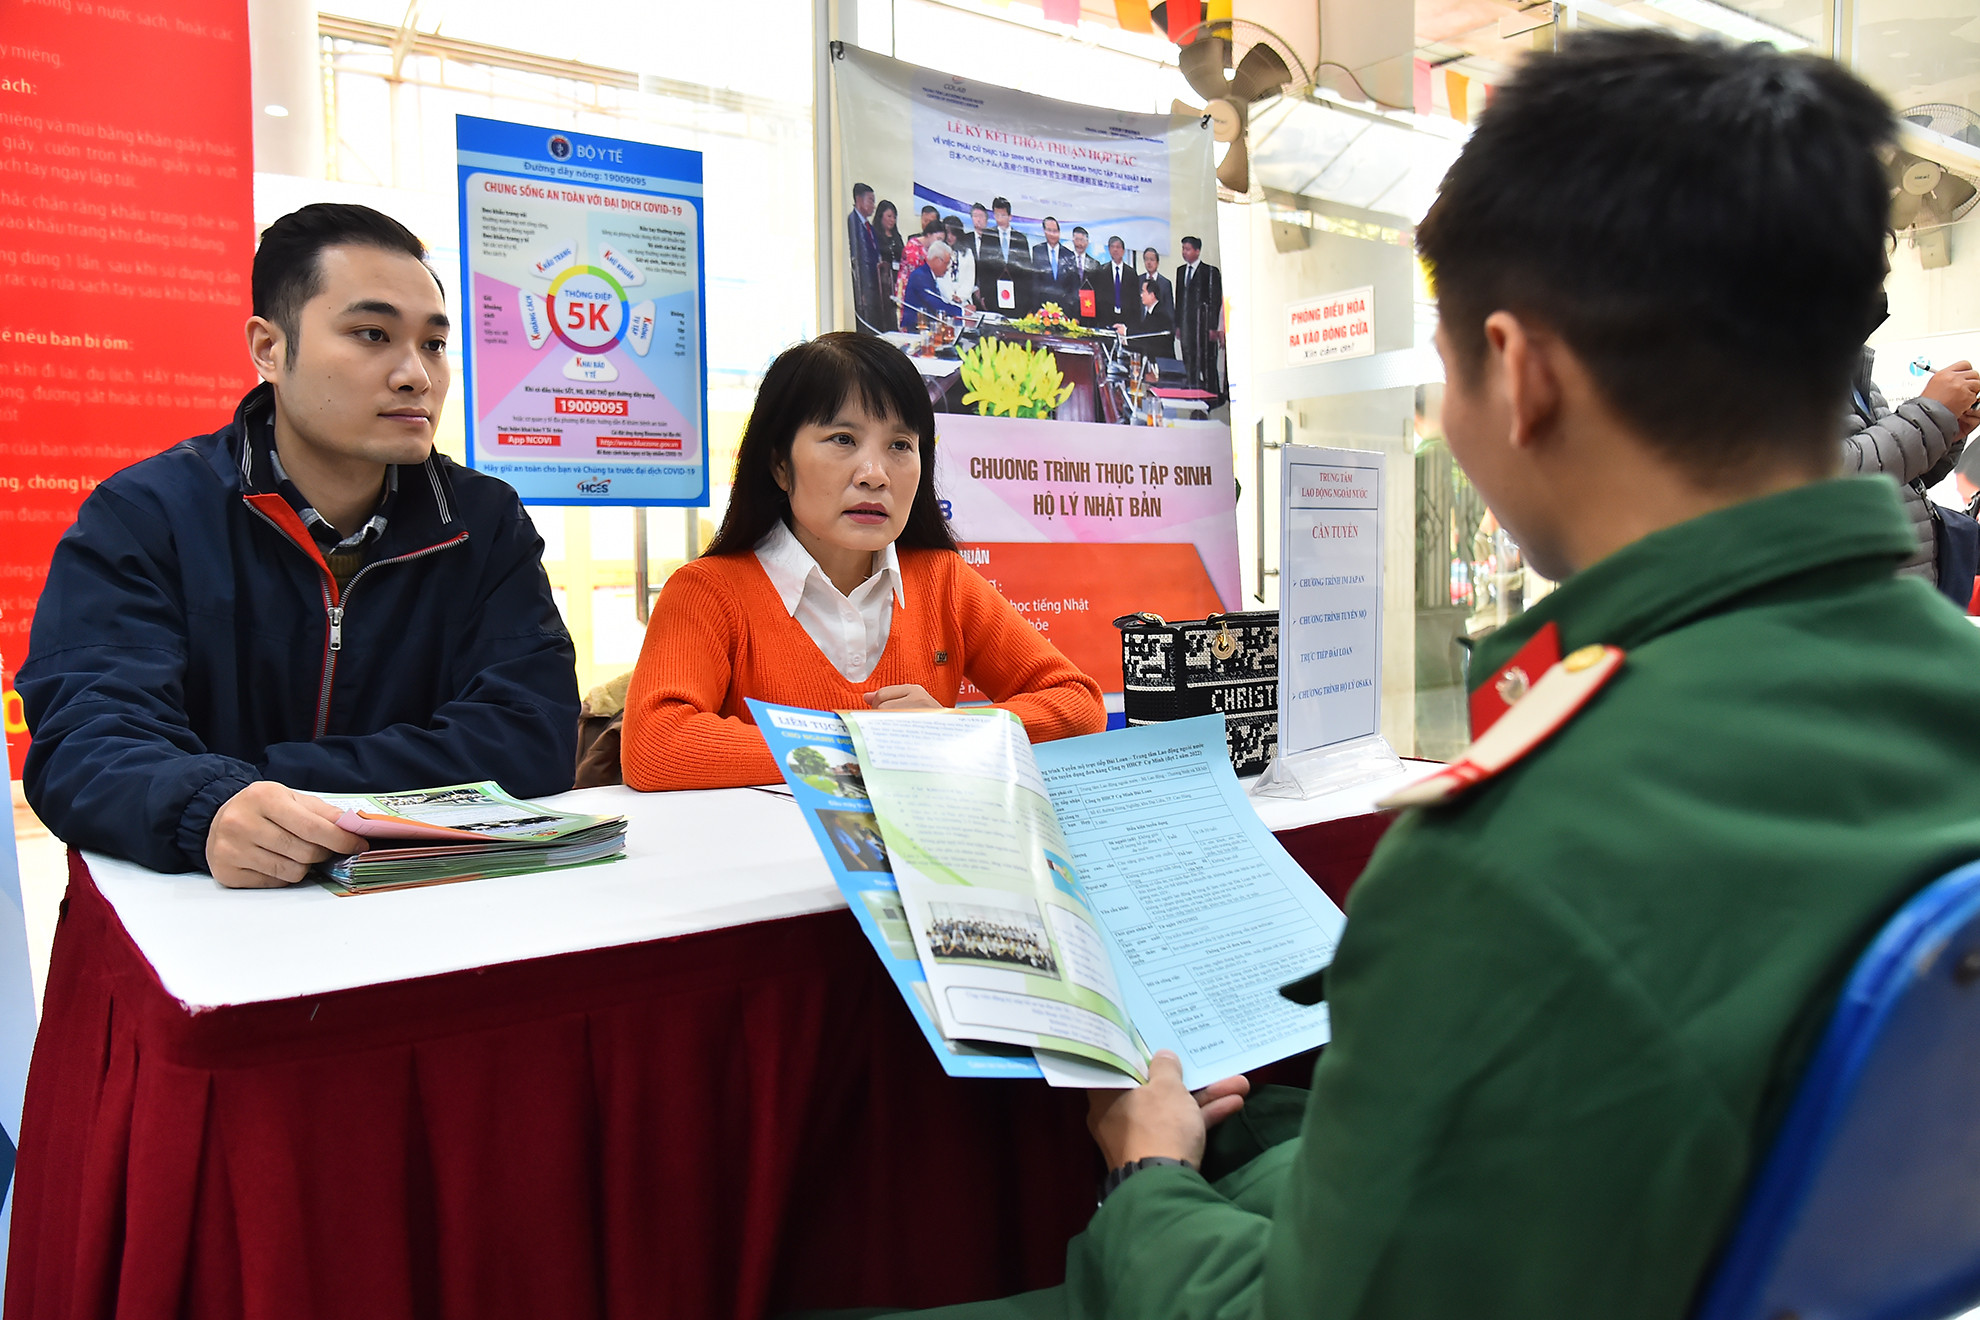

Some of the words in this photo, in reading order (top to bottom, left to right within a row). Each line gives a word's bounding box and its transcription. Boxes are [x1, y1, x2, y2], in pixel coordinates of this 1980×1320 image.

[577, 144, 596, 162] BỘ
[598, 148, 606, 160] Y
[608, 148, 623, 164] TẾ
[986, 128, 1009, 144] KẾT
[1048, 140, 1087, 160] THUẬN
[1088, 149, 1112, 164] HỢP
[1114, 152, 1138, 167] TÁC
[524, 162, 556, 175] Đường
[557, 166, 574, 178] dây
[604, 172, 647, 186] 19009095
[484, 181, 518, 196] CHUNG
[520, 184, 545, 199] SỐNG
[547, 190, 560, 200] AN
[562, 190, 585, 204] TOÀN
[587, 194, 602, 206] VỚI
[604, 196, 619, 210] ĐẠI
[621, 199, 642, 212] DỊCH
[644, 202, 682, 216] COVID-19
[564, 289, 593, 300] THÔNG
[567, 302, 610, 332] 5K
[1292, 307, 1321, 326] PHÒNG
[1324, 300, 1344, 319] ĐIỀU
[1347, 298, 1365, 314] HÒA
[15, 327, 47, 345] nếu
[1290, 334, 1300, 347] RA
[1302, 329, 1320, 344] VÀO
[1350, 318, 1368, 336] CỬA
[560, 400, 624, 414] 19009095
[508, 436, 526, 445] App
[526, 436, 552, 444] NCOVI
[544, 466, 556, 474] cho
[970, 457, 1038, 481] CHƯƠNG
[1044, 457, 1090, 482] TRÌNH
[1096, 462, 1134, 488] THỰC
[1139, 461, 1169, 489] TẬP
[1174, 465, 1212, 486] SINH
[1320, 472, 1340, 482] TRUNG
[1340, 472, 1353, 483] TÂM
[1302, 488, 1314, 498] LAO
[1316, 486, 1332, 500] ĐỘNG
[1033, 490, 1055, 520] HỘ
[1060, 491, 1078, 516] LÝ
[1084, 493, 1124, 522] NHẬT
[1130, 490, 1162, 518] BẢN
[1312, 522, 1330, 539] CẦN
[1300, 578, 1324, 588] CHƯƠNG
[1324, 574, 1340, 586] TRÌNH
[1348, 575, 1365, 584] JAPAN
[1033, 596, 1062, 614] tiếng
[1064, 598, 1089, 614] Nhật
[1300, 614, 1324, 626] CHƯƠNG
[1324, 611, 1340, 622] TRÌNH
[1339, 646, 1352, 656] LOAN
[1298, 688, 1322, 700] CHƯƠNG
[1323, 682, 1340, 696] TRÌNH
[1356, 678, 1372, 688] OSAKA
